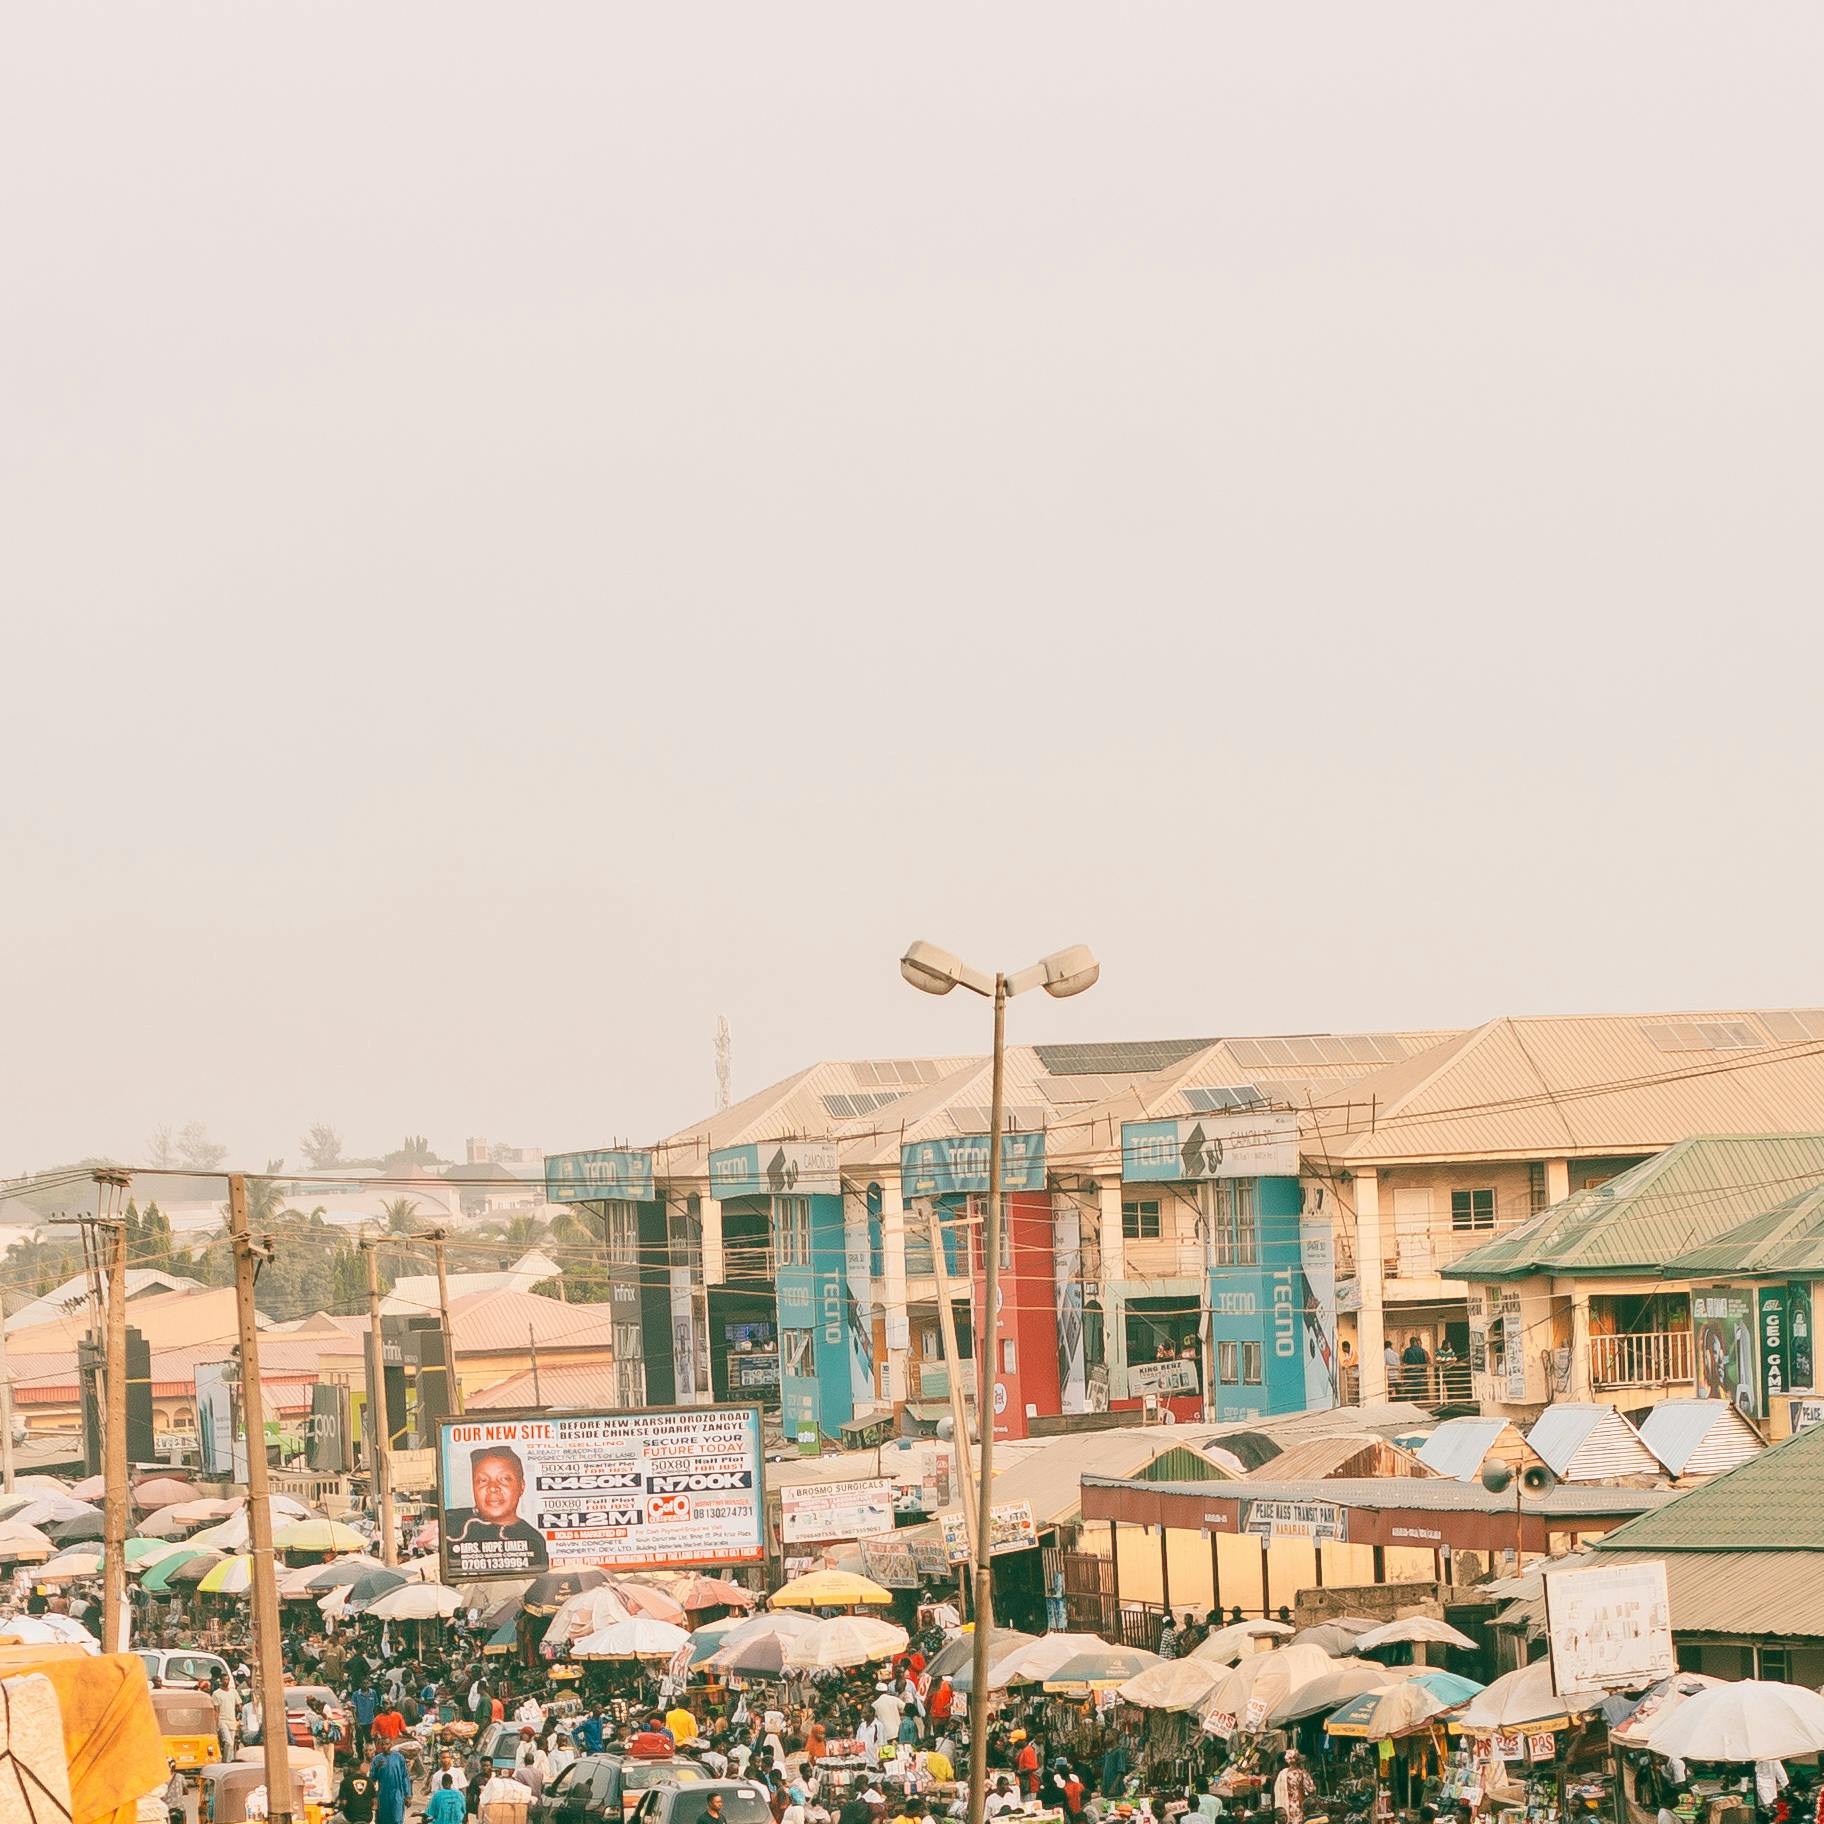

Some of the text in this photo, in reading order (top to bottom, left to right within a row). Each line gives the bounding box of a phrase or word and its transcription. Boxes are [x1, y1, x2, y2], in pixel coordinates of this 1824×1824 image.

[1130, 1135, 1175, 1167] TECNO
[584, 1159, 618, 1187] TECNO
[716, 1157, 749, 1184] TECNO
[824, 1267, 841, 1344] TECNO
[1218, 1292, 1256, 1316] TECNO
[1273, 1265, 1294, 1357] TECNO
[1767, 1316, 1781, 1348] GEO
[559, 1421, 601, 1431] BEFORE
[719, 1412, 751, 1421] ROAD
[453, 1426, 482, 1442] OUR
[486, 1425, 517, 1441] NEW
[559, 1430, 600, 1440] BESIDE
[602, 1427, 649, 1438] CHINESE
[642, 1434, 743, 1447] SECURE YOUR
[568, 1440, 625, 1448] SELLING
[642, 1442, 744, 1457] FUTURE TODAY
[796, 1480, 885, 1497] BROSMO SURGICALS
[1255, 1503, 1274, 1519] PEACE
[1294, 1506, 1318, 1521] TRANSIT
[1320, 1507, 1336, 1523] PARK
[482, 1541, 504, 1553] HOPE
[1531, 1733, 1554, 1755] POS
